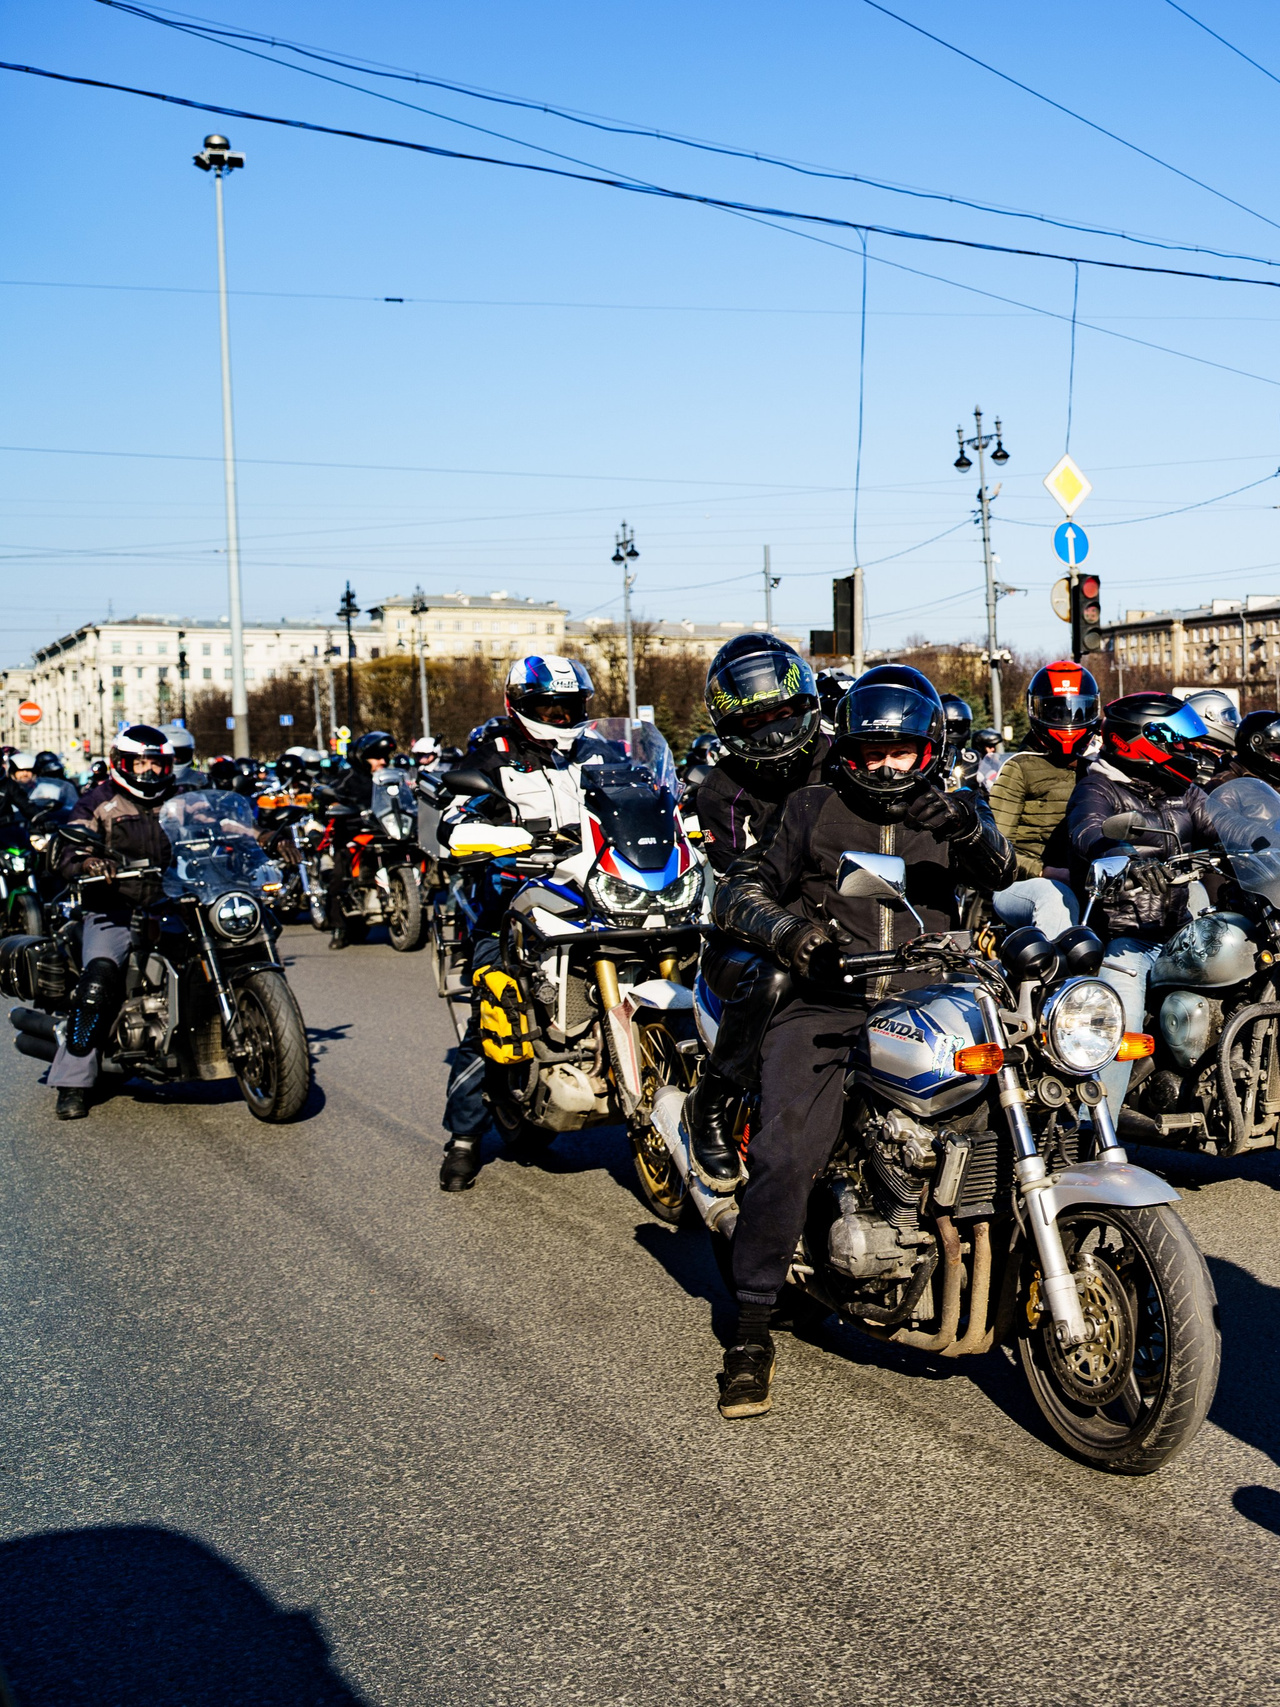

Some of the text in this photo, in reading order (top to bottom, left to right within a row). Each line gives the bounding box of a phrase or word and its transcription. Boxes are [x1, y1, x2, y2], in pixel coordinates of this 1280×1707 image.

[1111, 734, 1129, 752] SHOEI
[637, 837, 657, 845] GIVI
[868, 1016, 925, 1043] HONDA
